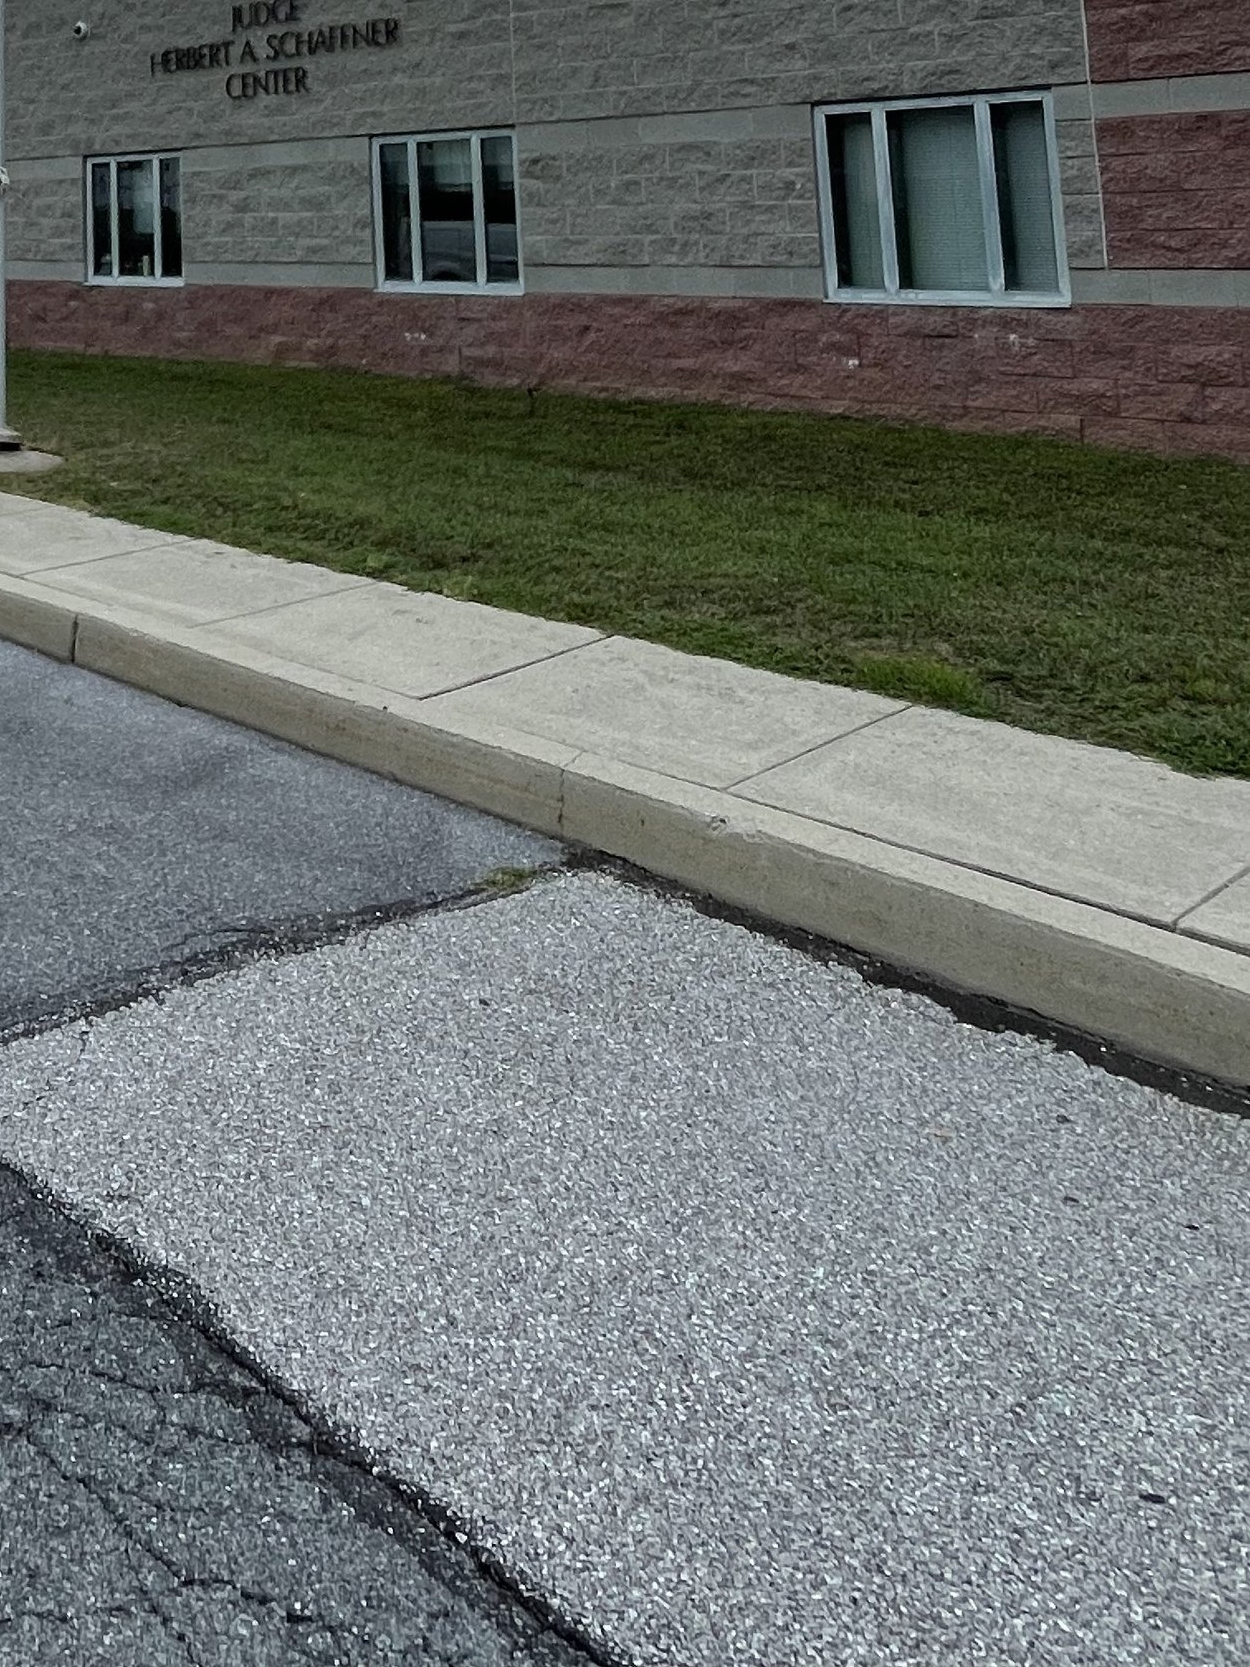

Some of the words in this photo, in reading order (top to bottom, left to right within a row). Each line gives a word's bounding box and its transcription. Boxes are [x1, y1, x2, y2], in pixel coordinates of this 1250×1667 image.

[150, 39, 234, 76] HERBERT
[265, 18, 401, 61] SCHAFFNER
[225, 66, 310, 99] CENTER
